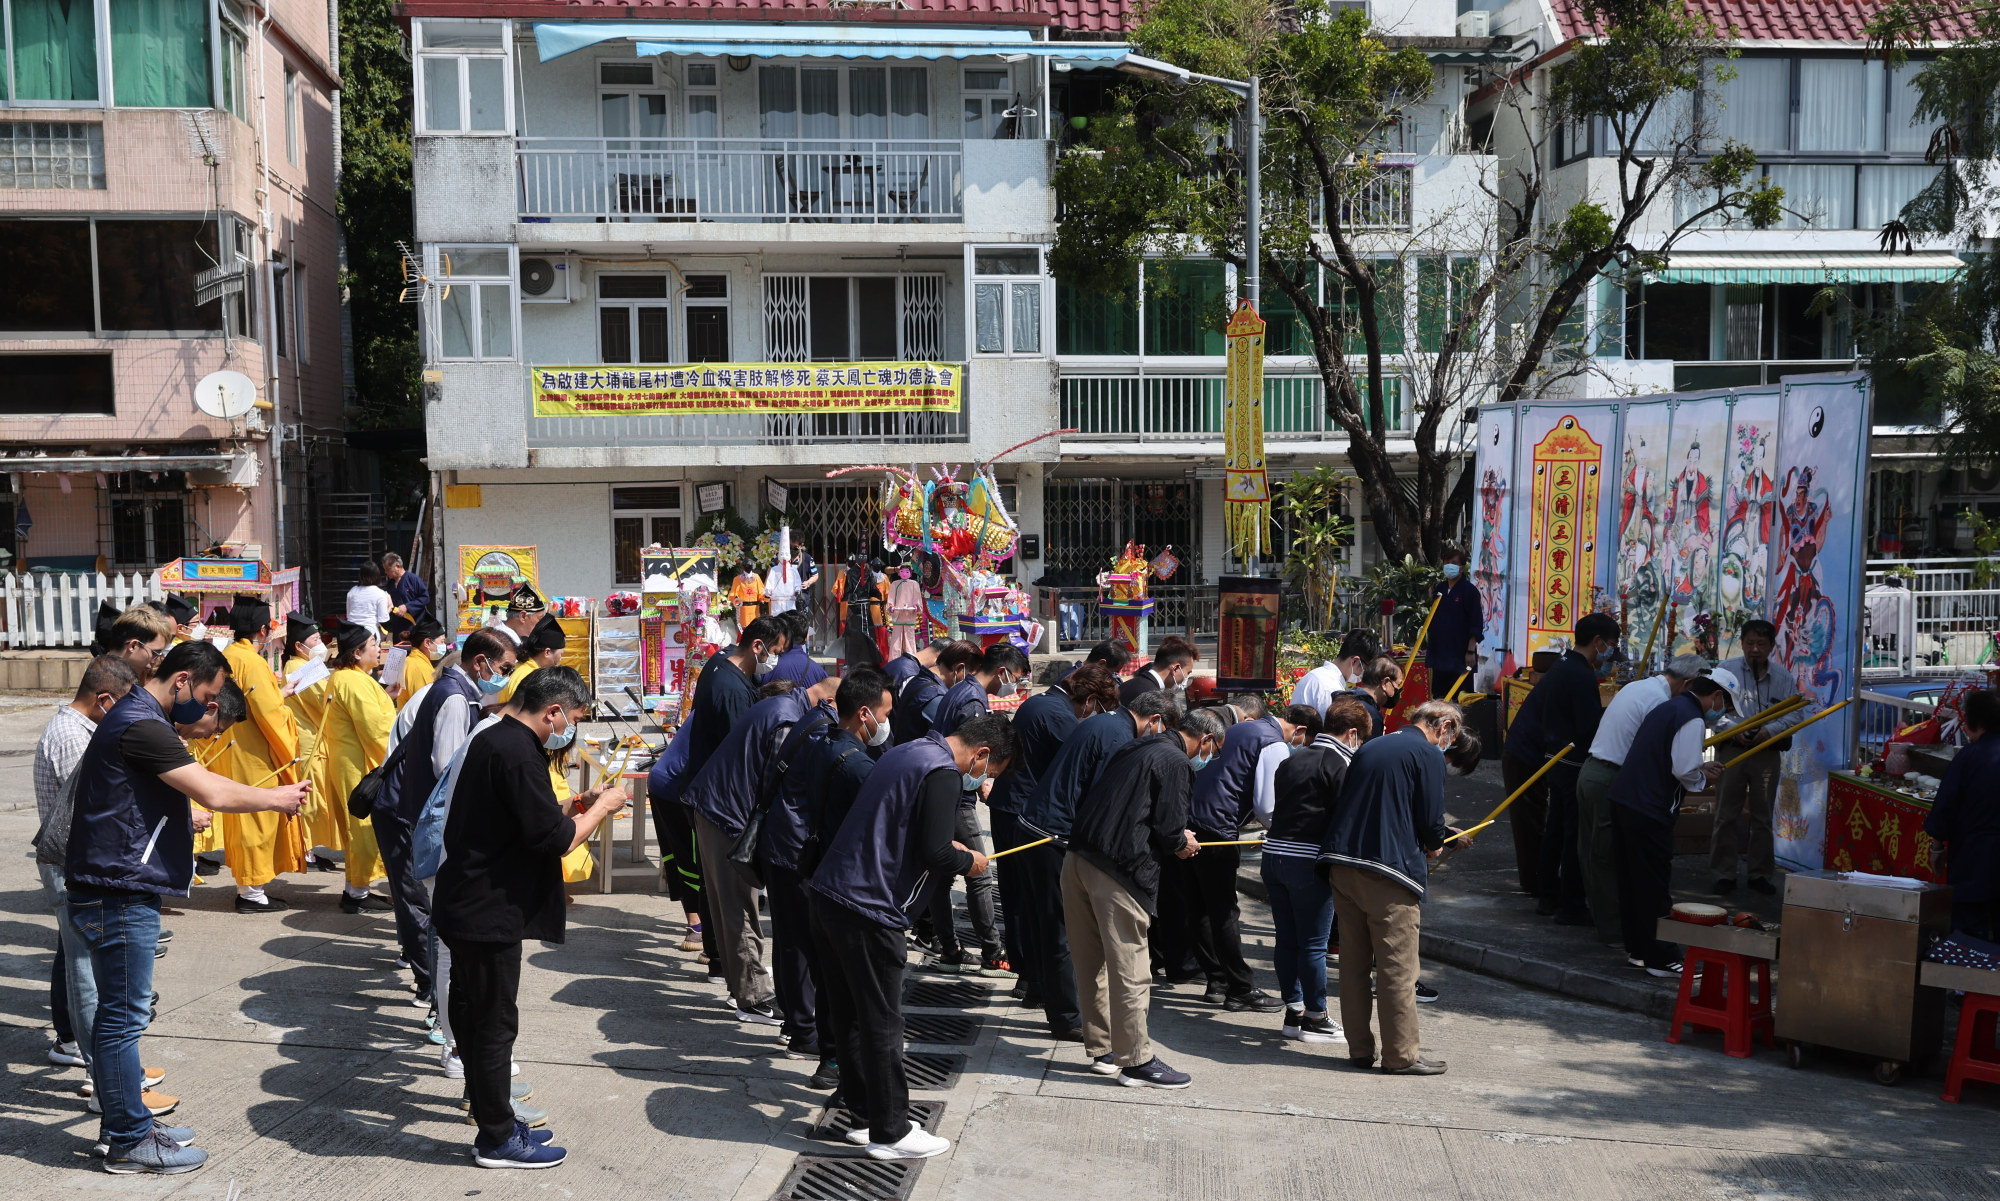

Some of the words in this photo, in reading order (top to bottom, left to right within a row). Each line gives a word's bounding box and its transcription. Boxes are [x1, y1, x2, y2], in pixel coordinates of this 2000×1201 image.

[1549, 471, 1573, 623] 三清三寶天尊
